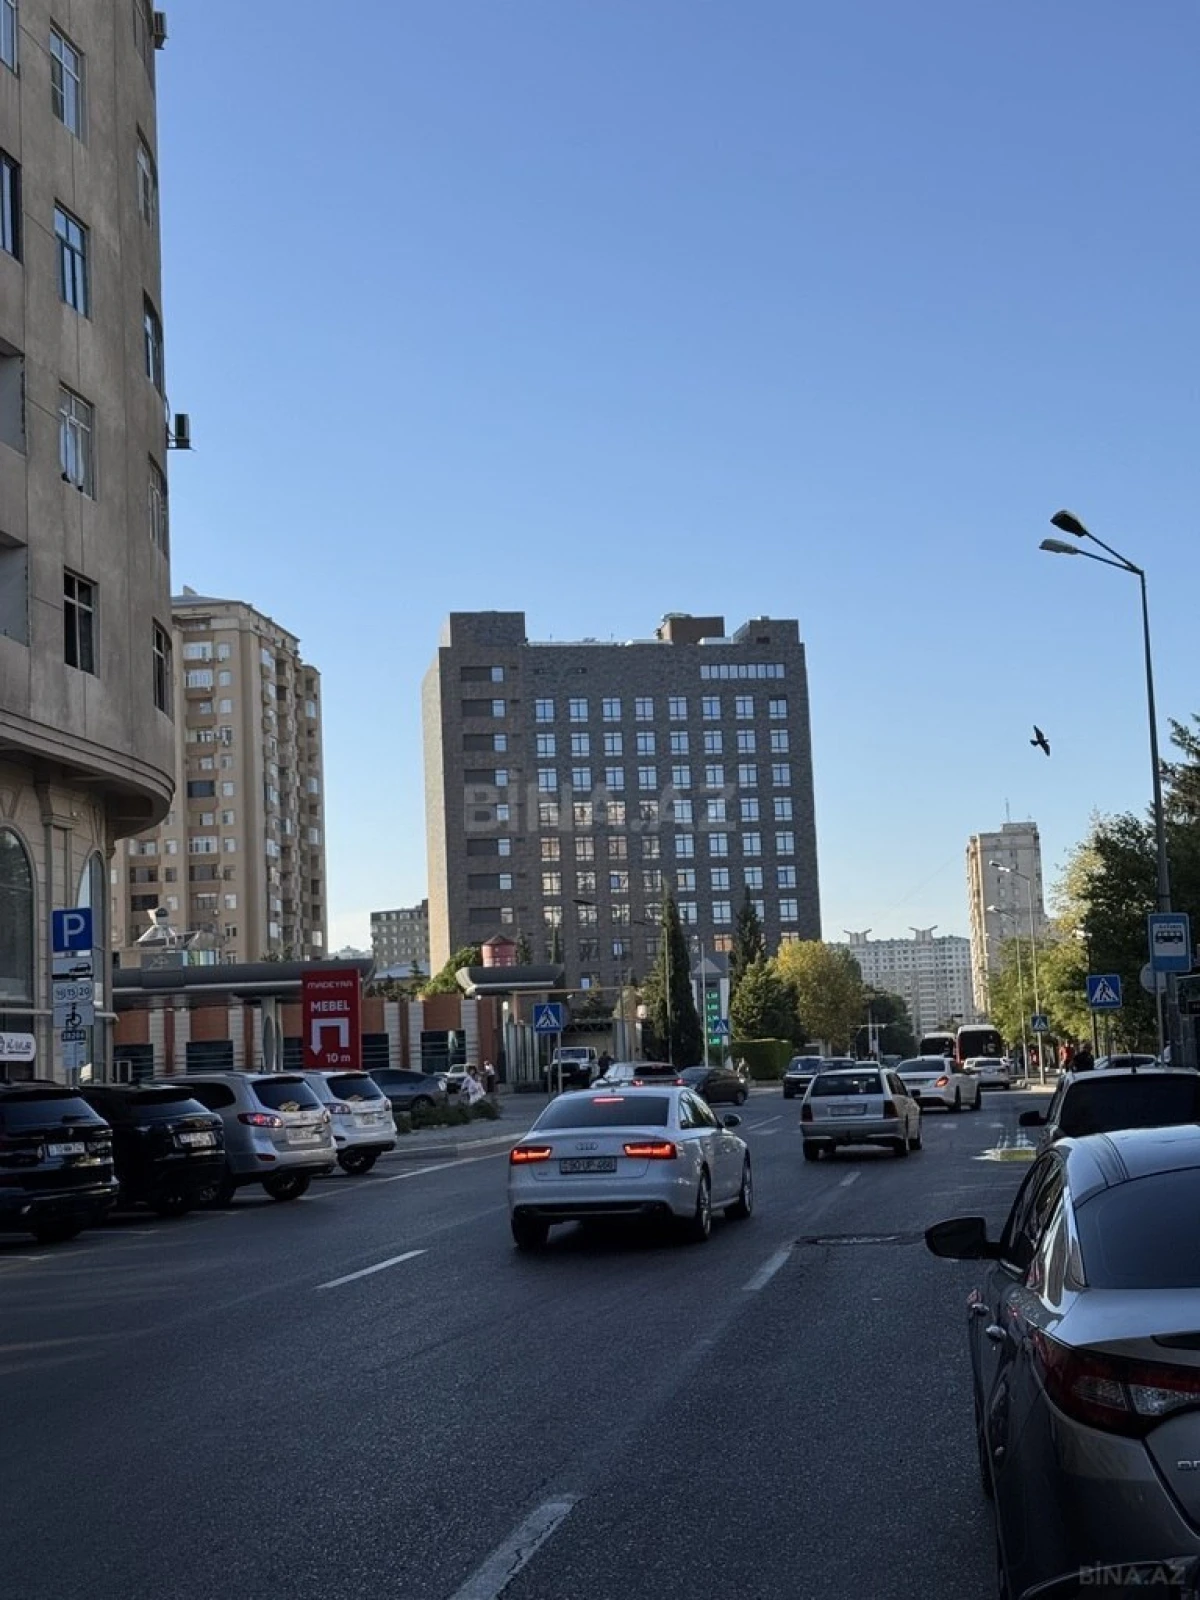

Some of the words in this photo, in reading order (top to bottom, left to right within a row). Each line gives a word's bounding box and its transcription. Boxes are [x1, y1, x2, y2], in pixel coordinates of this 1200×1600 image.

[62, 914, 86, 948] P
[310, 1000, 350, 1012] MEBEL
[326, 1053, 339, 1063] 10
[340, 1054, 351, 1062] m
